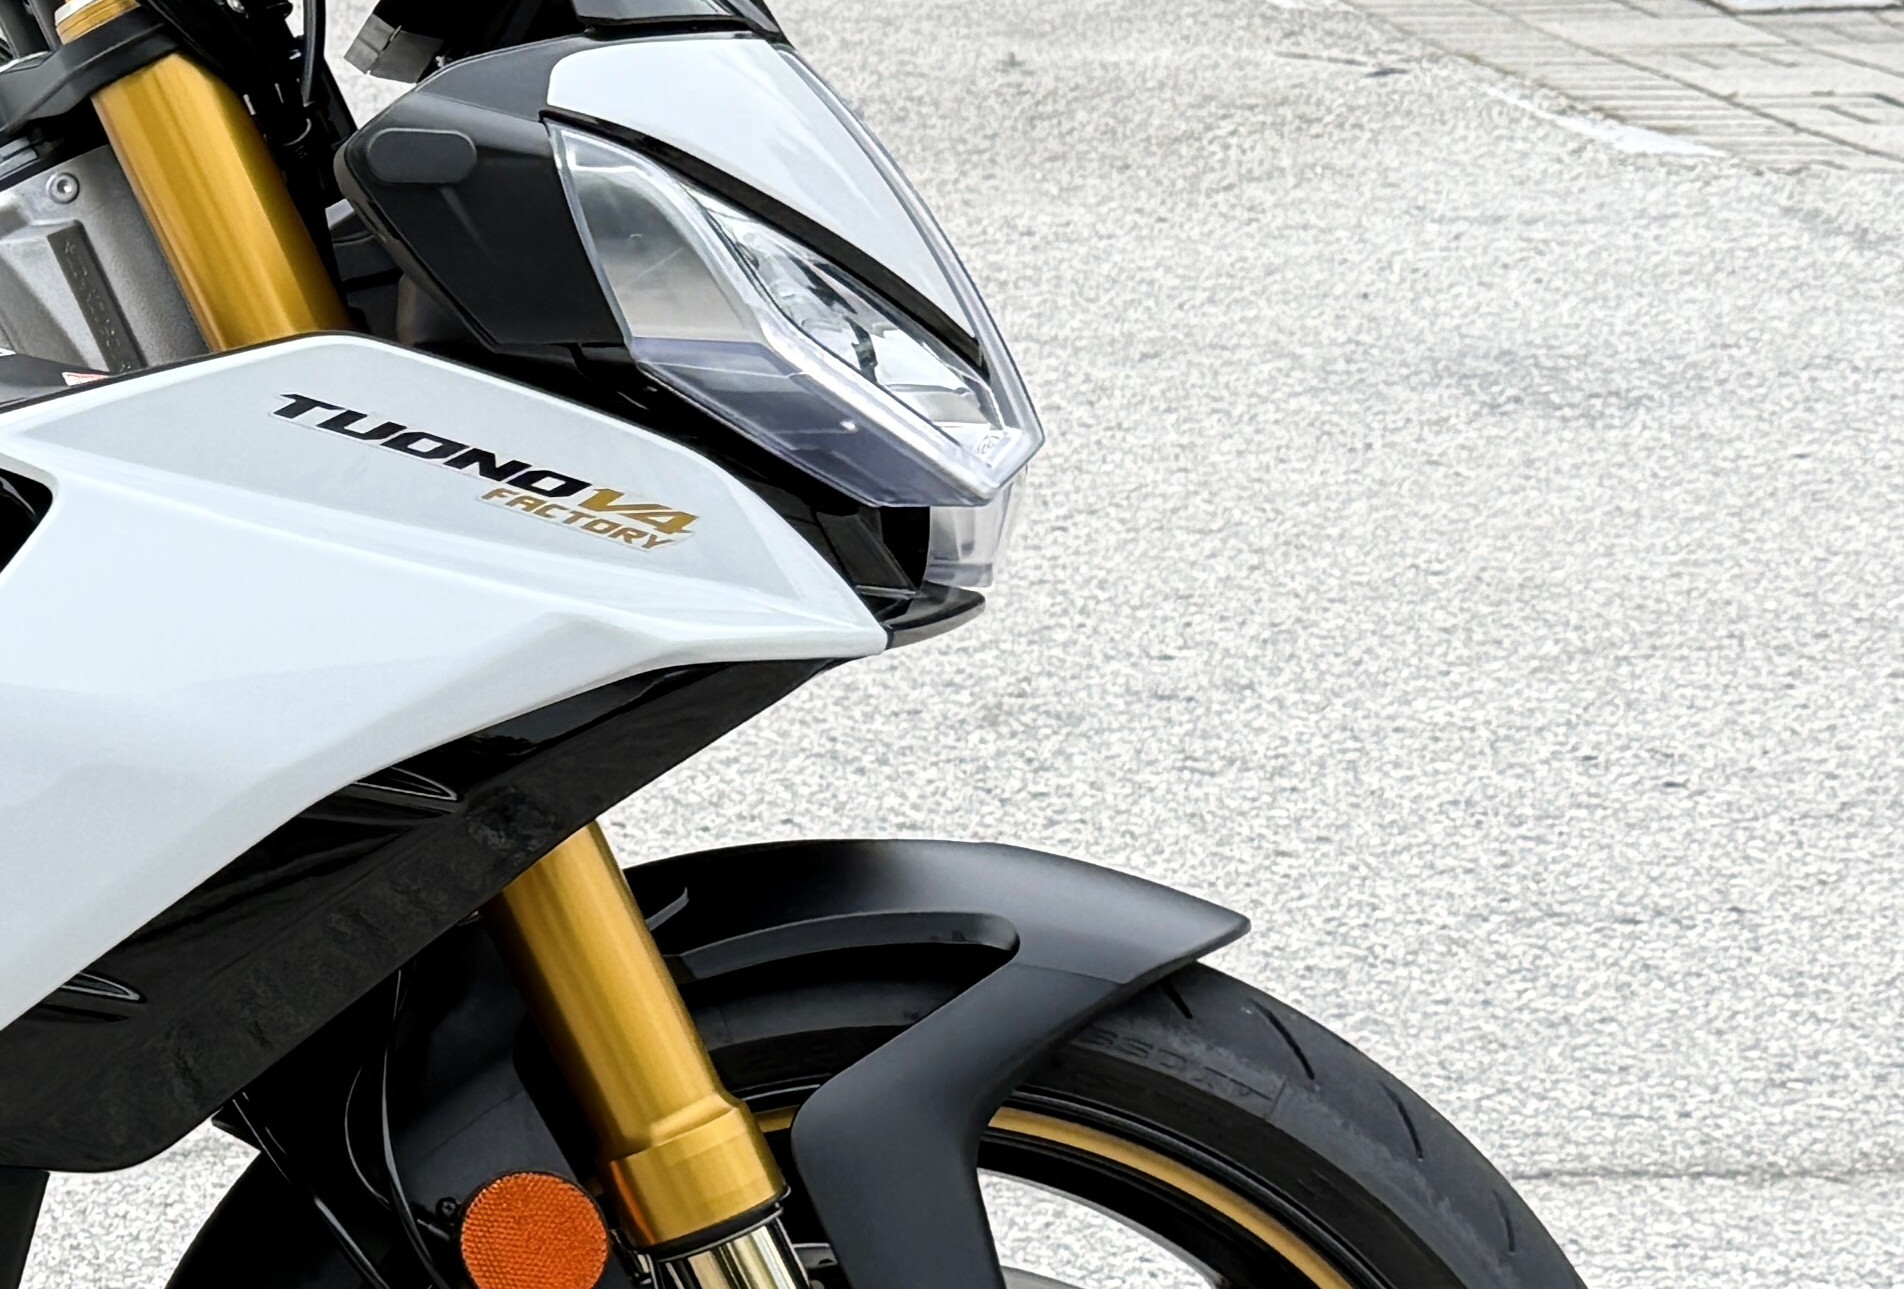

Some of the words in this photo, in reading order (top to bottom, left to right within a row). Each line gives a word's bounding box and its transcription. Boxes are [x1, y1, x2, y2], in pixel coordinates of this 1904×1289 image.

[273, 393, 591, 497] TUONO
[580, 488, 699, 535] V4
[480, 488, 673, 549] FACTORY
